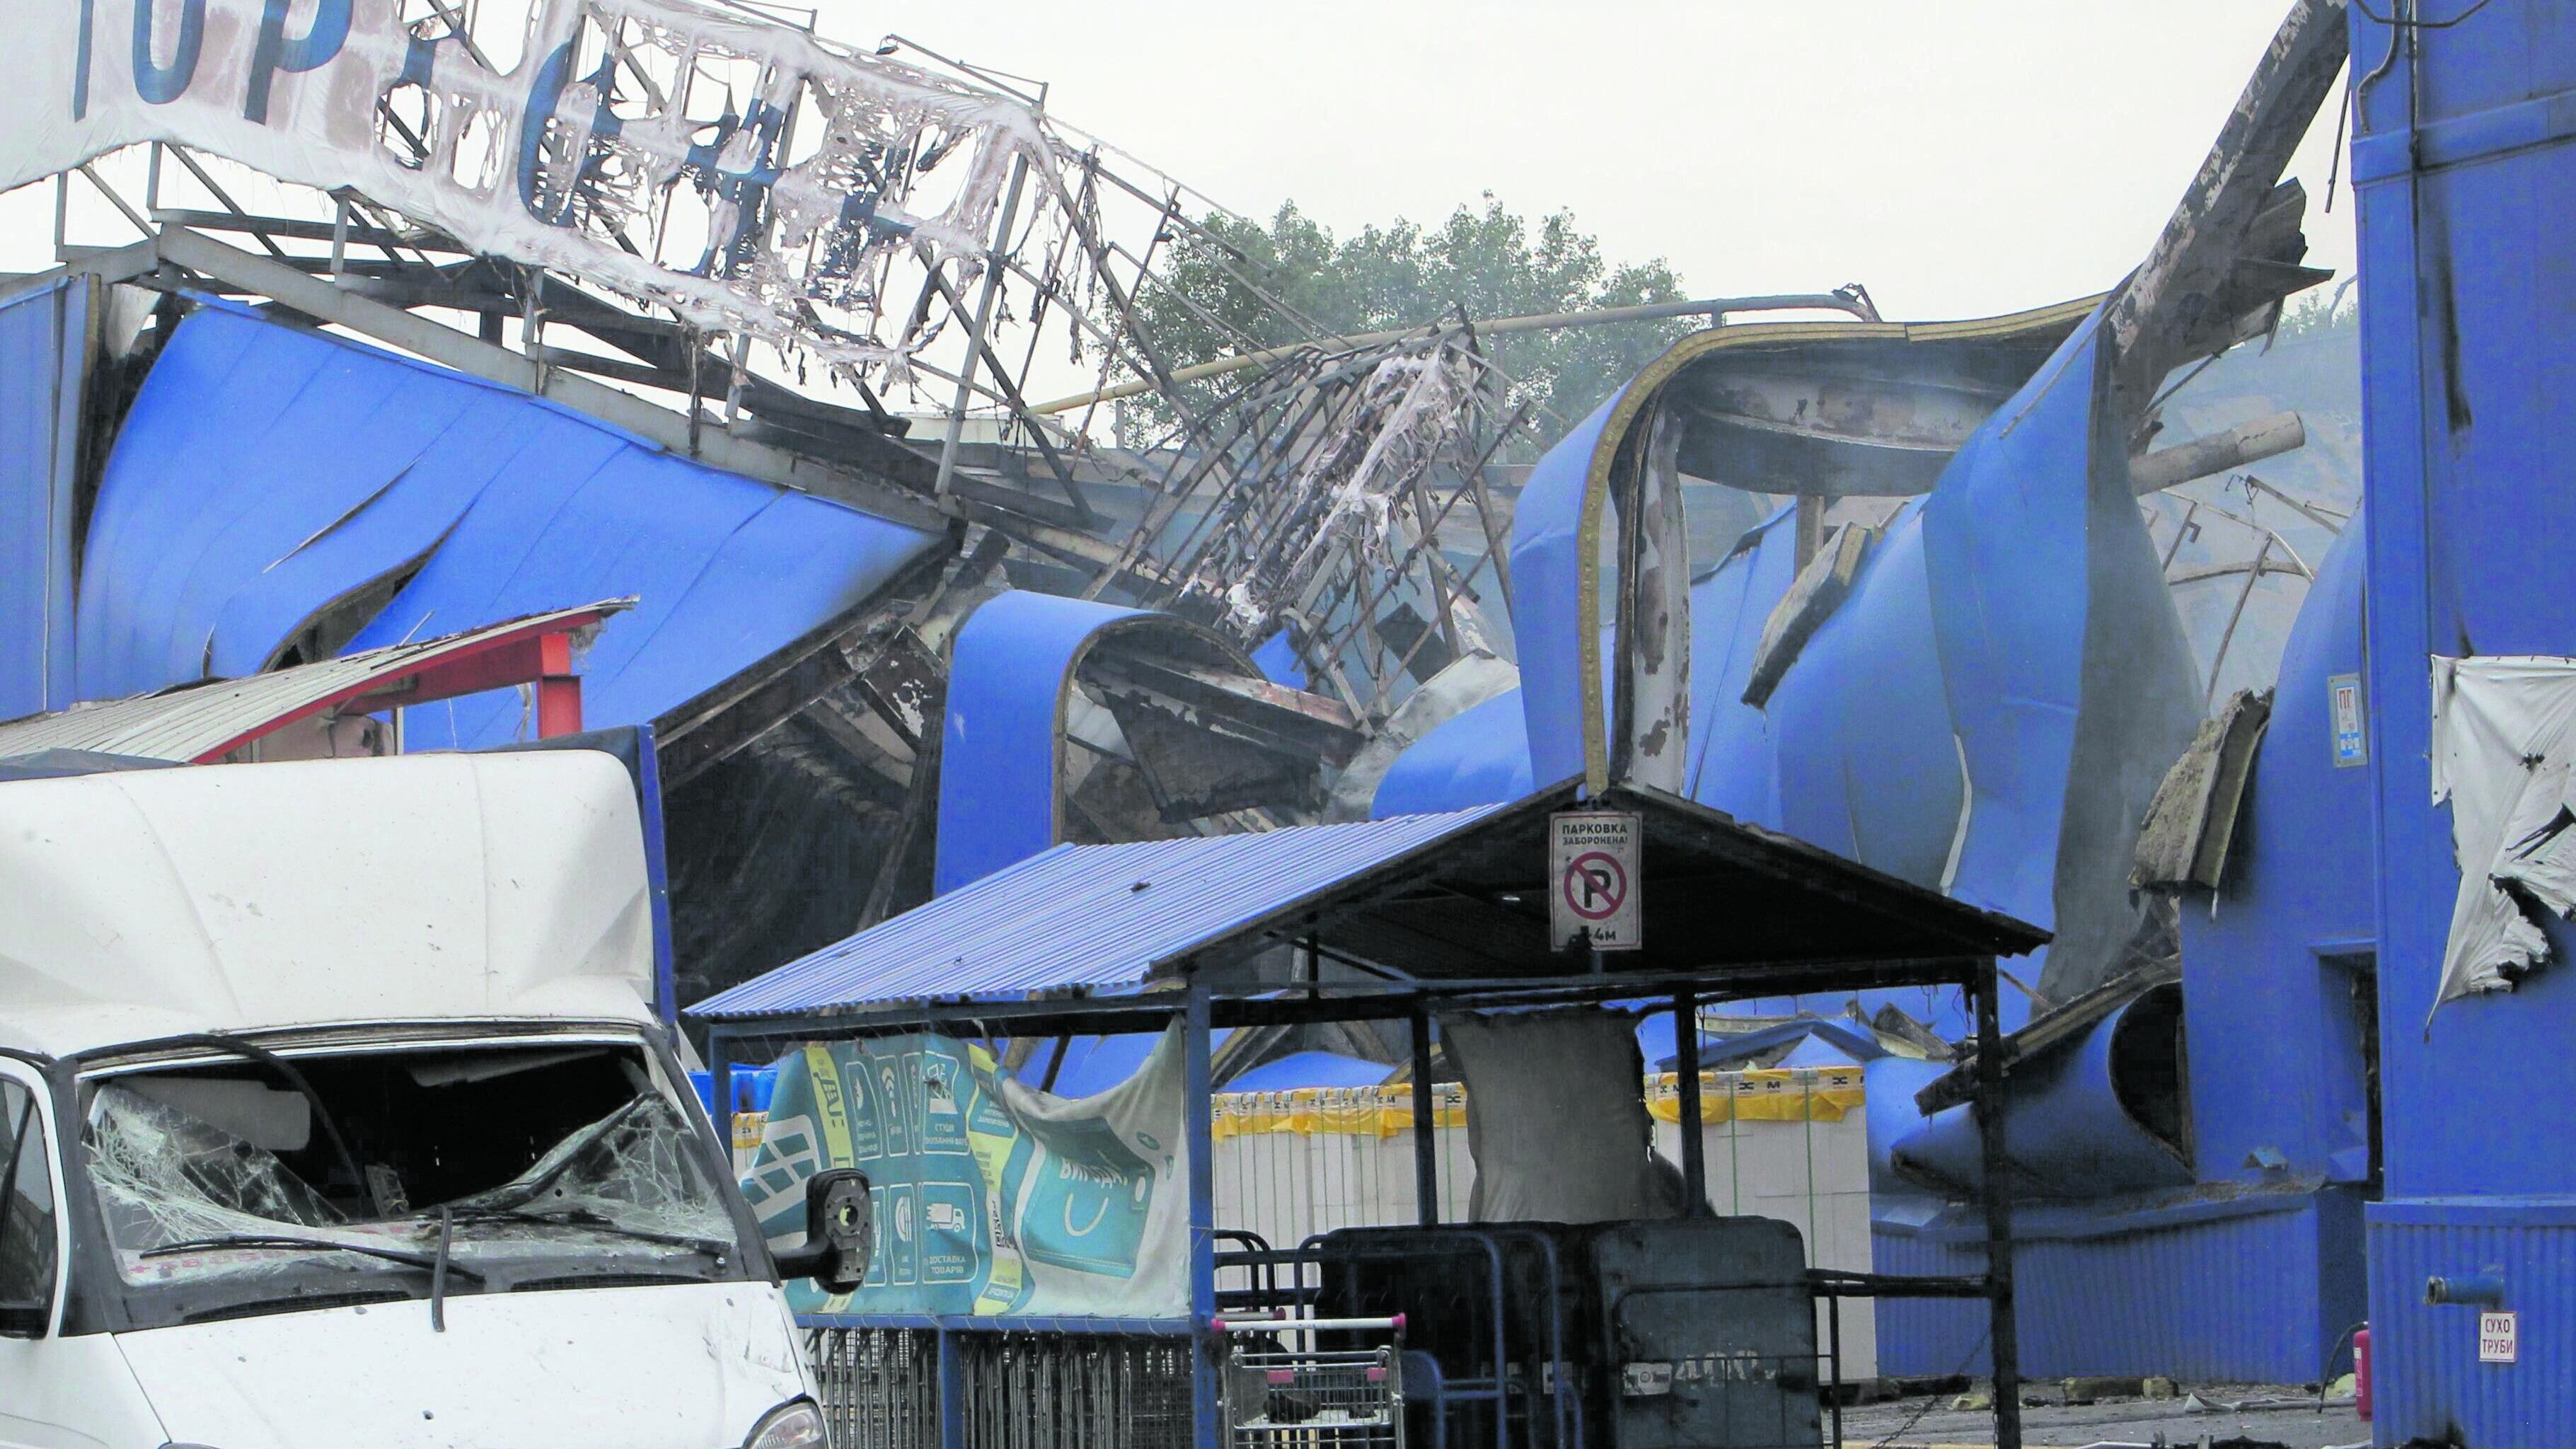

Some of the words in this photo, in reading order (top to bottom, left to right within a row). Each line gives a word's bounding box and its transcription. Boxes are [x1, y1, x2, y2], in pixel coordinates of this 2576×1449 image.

[1561, 823, 1628, 835] ПАРКОВКА
[1562, 836, 1628, 846] ЗАБОРОНЕНА!
[2485, 1318, 2510, 1334] СУХО
[2482, 1339, 2513, 1354] ТРУБИ
